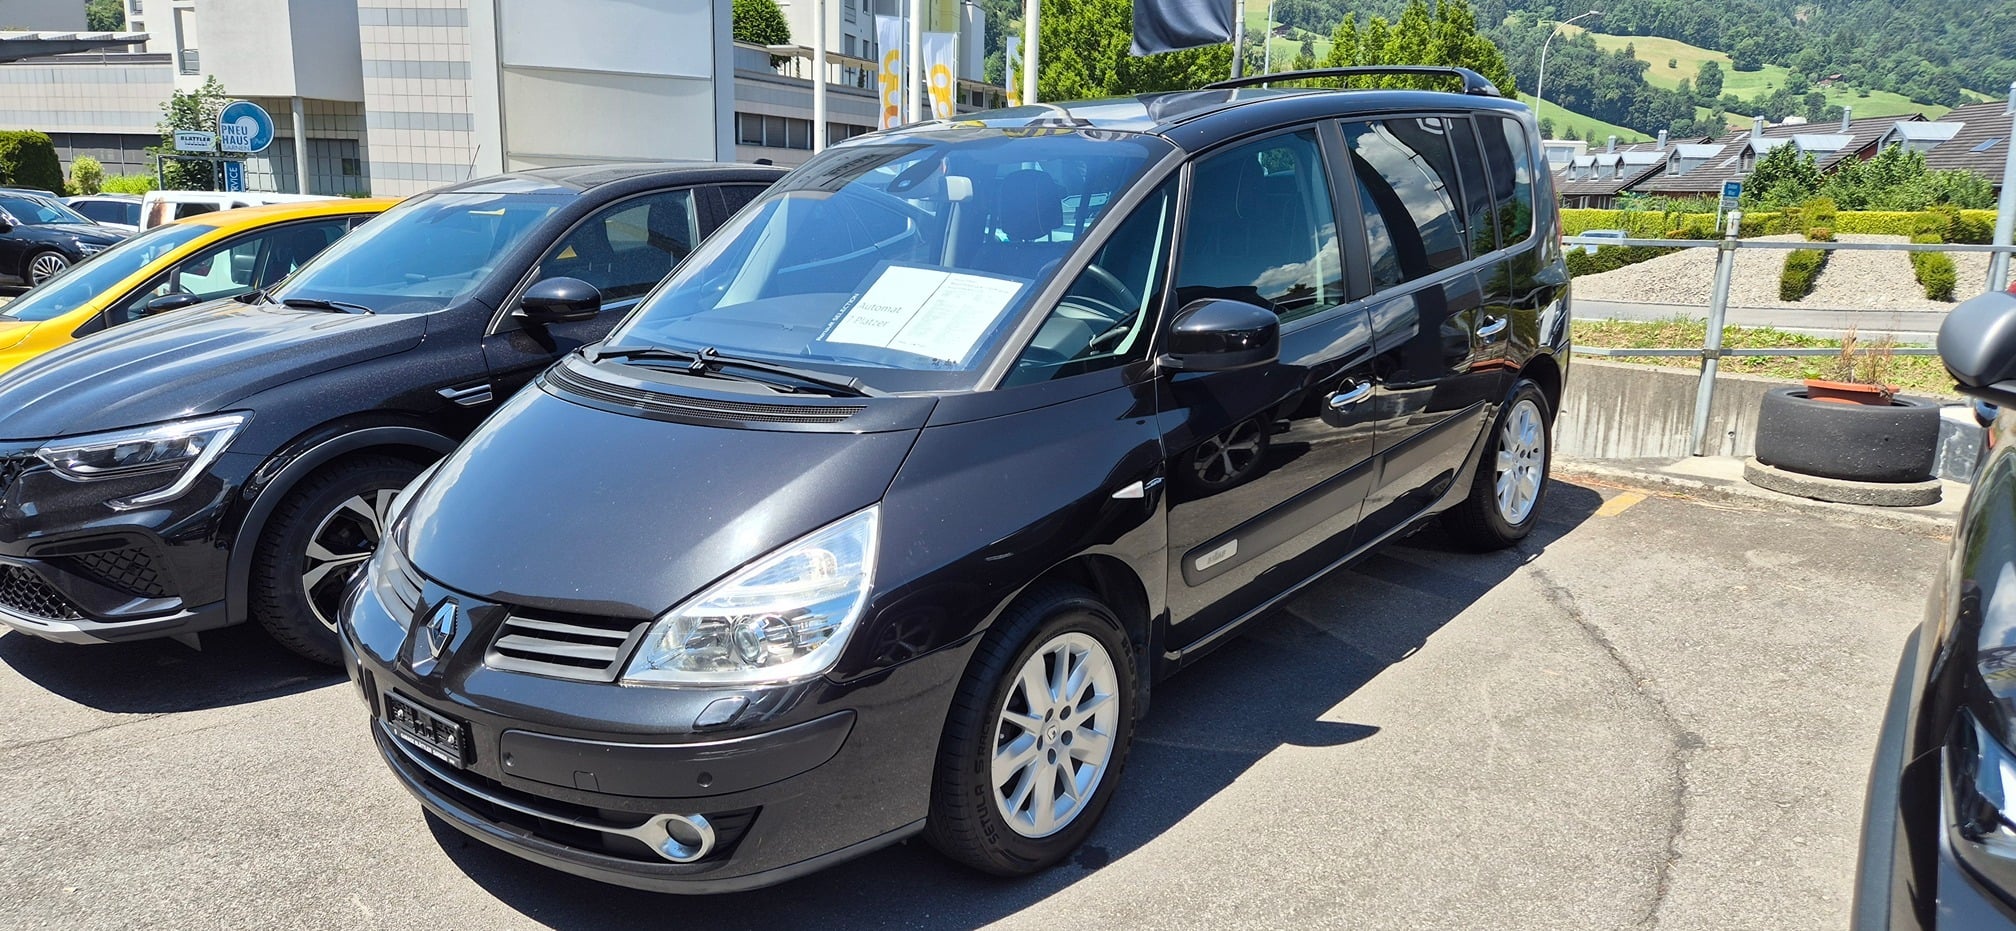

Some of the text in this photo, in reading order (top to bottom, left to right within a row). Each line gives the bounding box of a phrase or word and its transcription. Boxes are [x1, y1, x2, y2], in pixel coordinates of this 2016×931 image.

[221, 124, 248, 135] PNEU
[221, 135, 249, 145] HAUS
[229, 167, 239, 192] RVICE
[857, 302, 902, 314] Automat
[975, 783, 999, 845] SETULA
